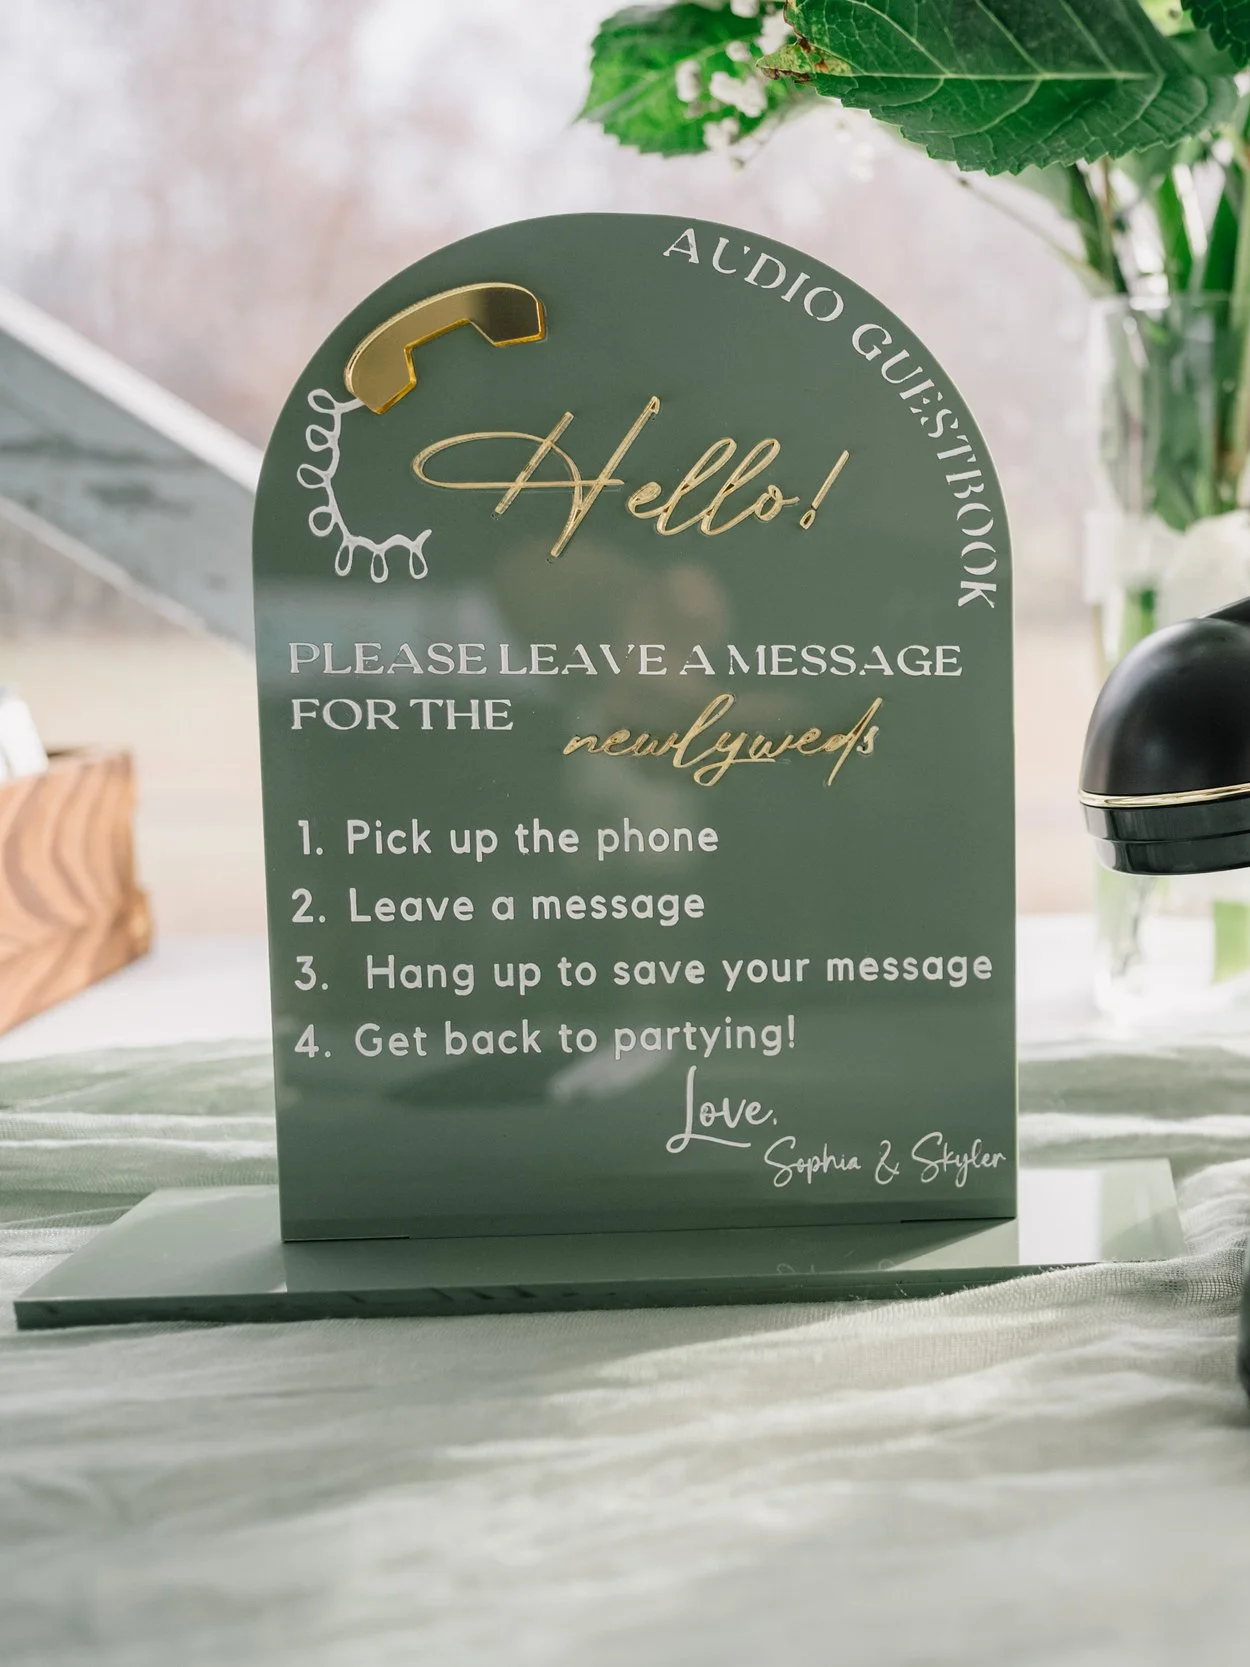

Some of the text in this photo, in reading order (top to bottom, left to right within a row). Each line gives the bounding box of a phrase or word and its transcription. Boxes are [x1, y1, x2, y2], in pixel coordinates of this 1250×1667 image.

[662, 228, 998, 609] AUDIO GUESTBOOK
[411, 396, 850, 559] Hello!
[288, 642, 963, 677] PLEASE LEAVE A MESSAGE
[290, 693, 883, 787] FOR THE newlyweds
[297, 817, 719, 863] 1. Pick up the phone
[291, 887, 705, 927] 2. Leave a message
[294, 954, 993, 996] 3. Hang up to save your message
[294, 1014, 796, 1060] 4. Get back to partying!
[763, 1131, 1007, 1188] Sophia & Skyler
